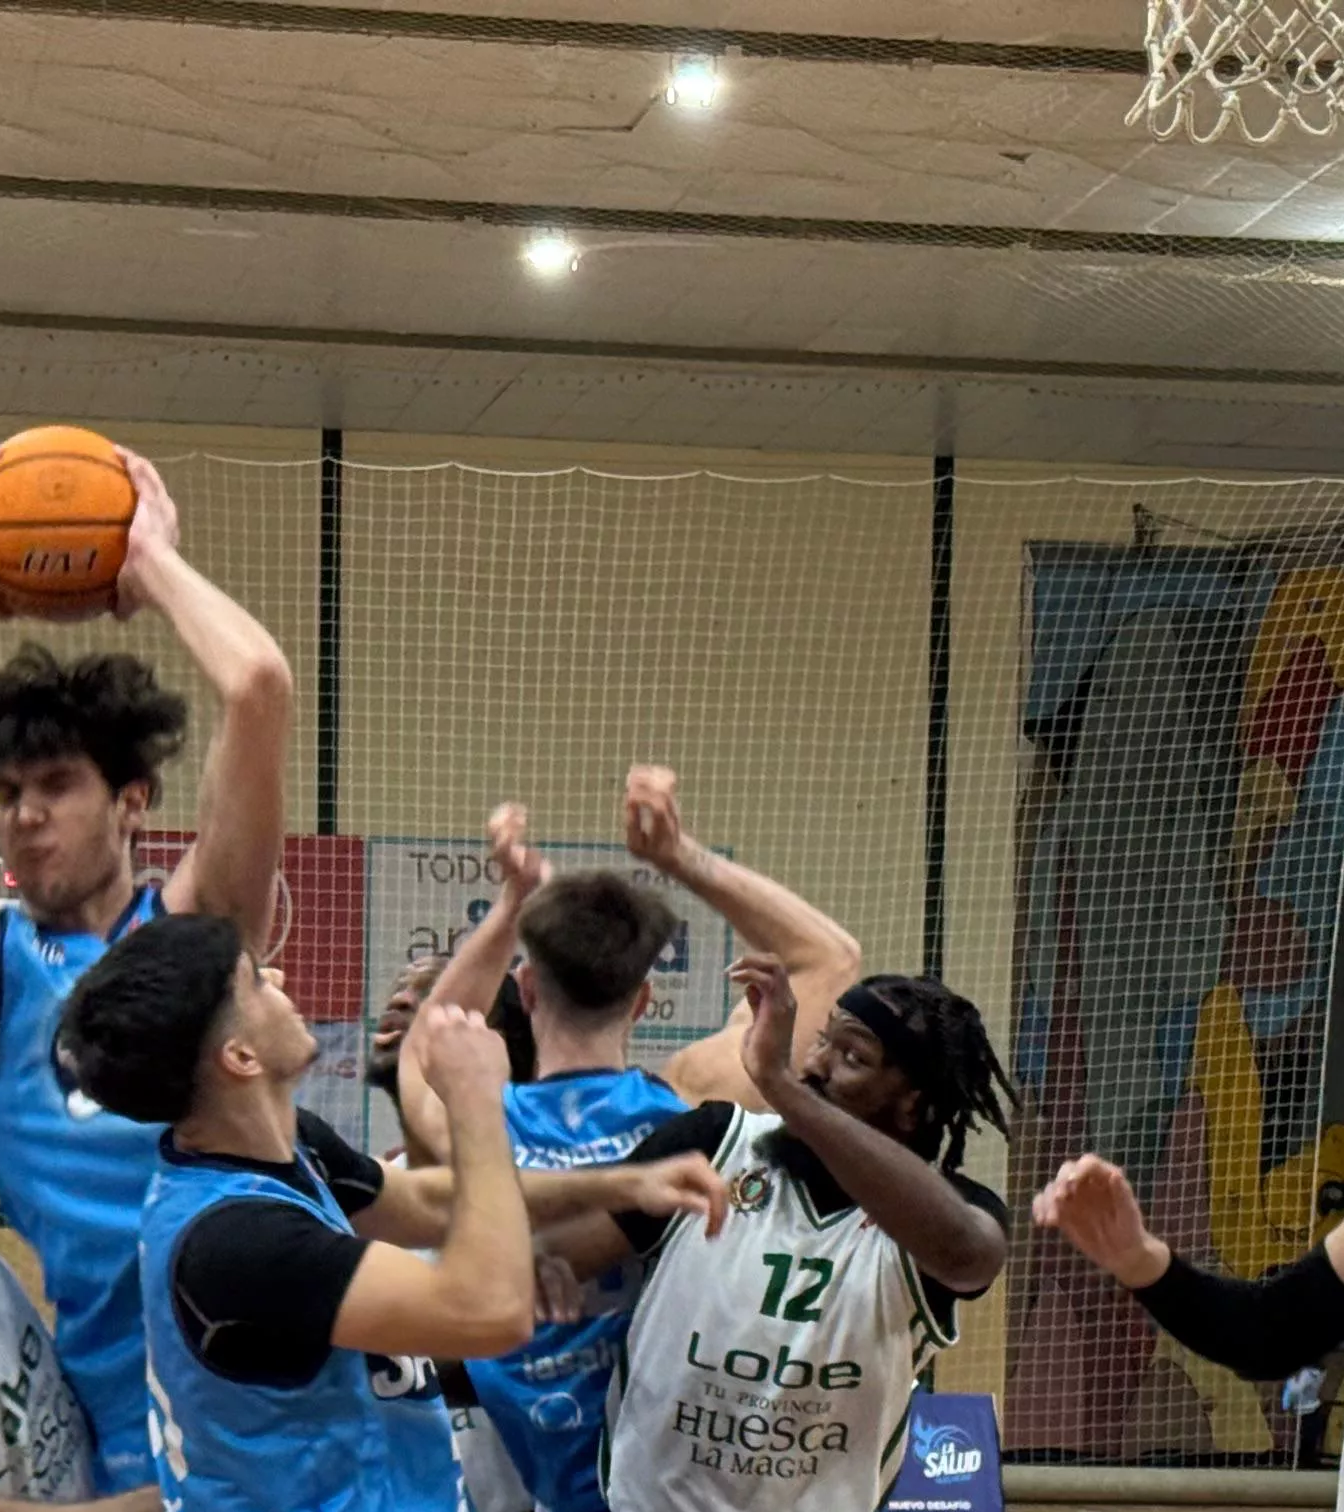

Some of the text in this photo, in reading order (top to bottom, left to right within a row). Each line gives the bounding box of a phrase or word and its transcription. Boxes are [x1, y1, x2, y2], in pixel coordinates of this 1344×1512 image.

[759, 1252, 835, 1323] 12
[687, 1330, 863, 1391] Lobe
[672, 1400, 849, 1454] Huesca
[923, 1448, 982, 1479] SALUD
